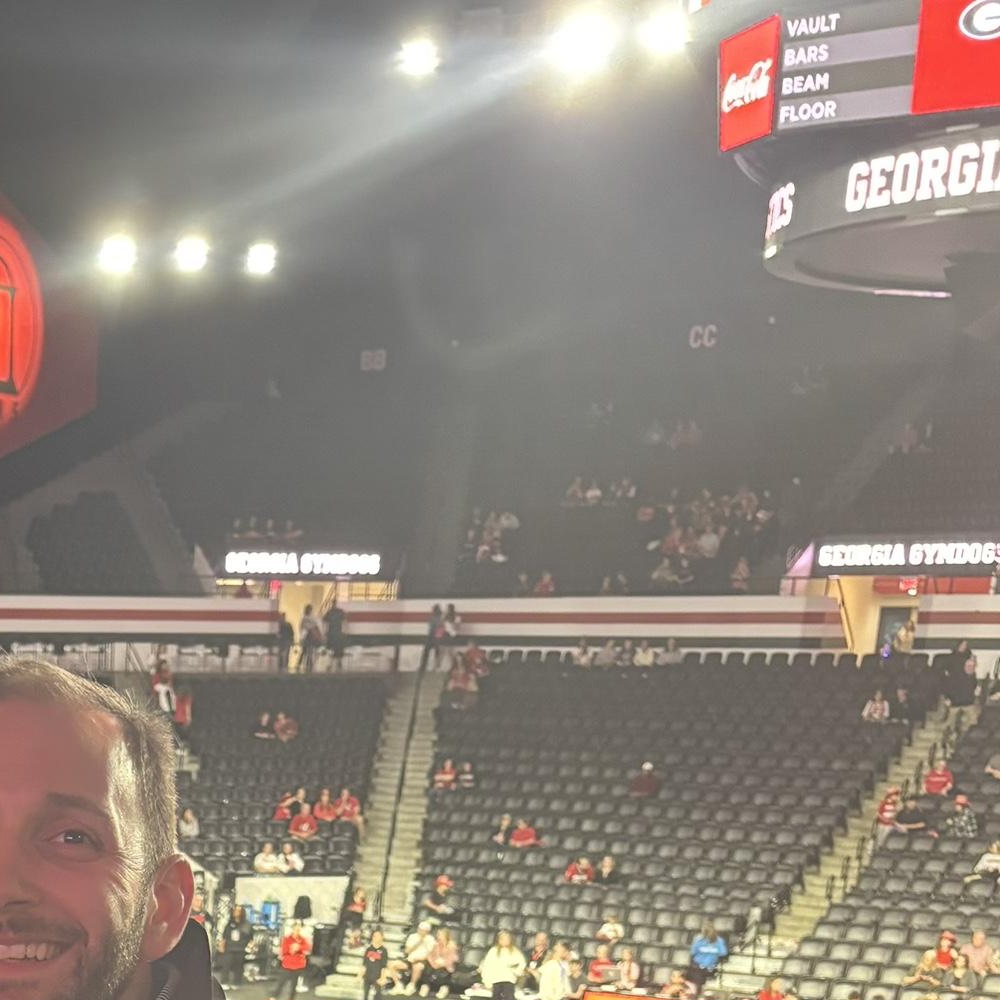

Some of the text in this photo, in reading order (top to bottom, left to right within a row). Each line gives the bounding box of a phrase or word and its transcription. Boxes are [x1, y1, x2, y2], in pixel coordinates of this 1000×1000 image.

[787, 13, 840, 37] VAULT
[784, 45, 829, 66] BARS
[781, 73, 830, 95] BEAM
[779, 101, 837, 124] FLOOR
[845, 139, 1000, 213] GEORGI
[688, 325, 717, 348] CC
[818, 544, 905, 566] GEORGIA
